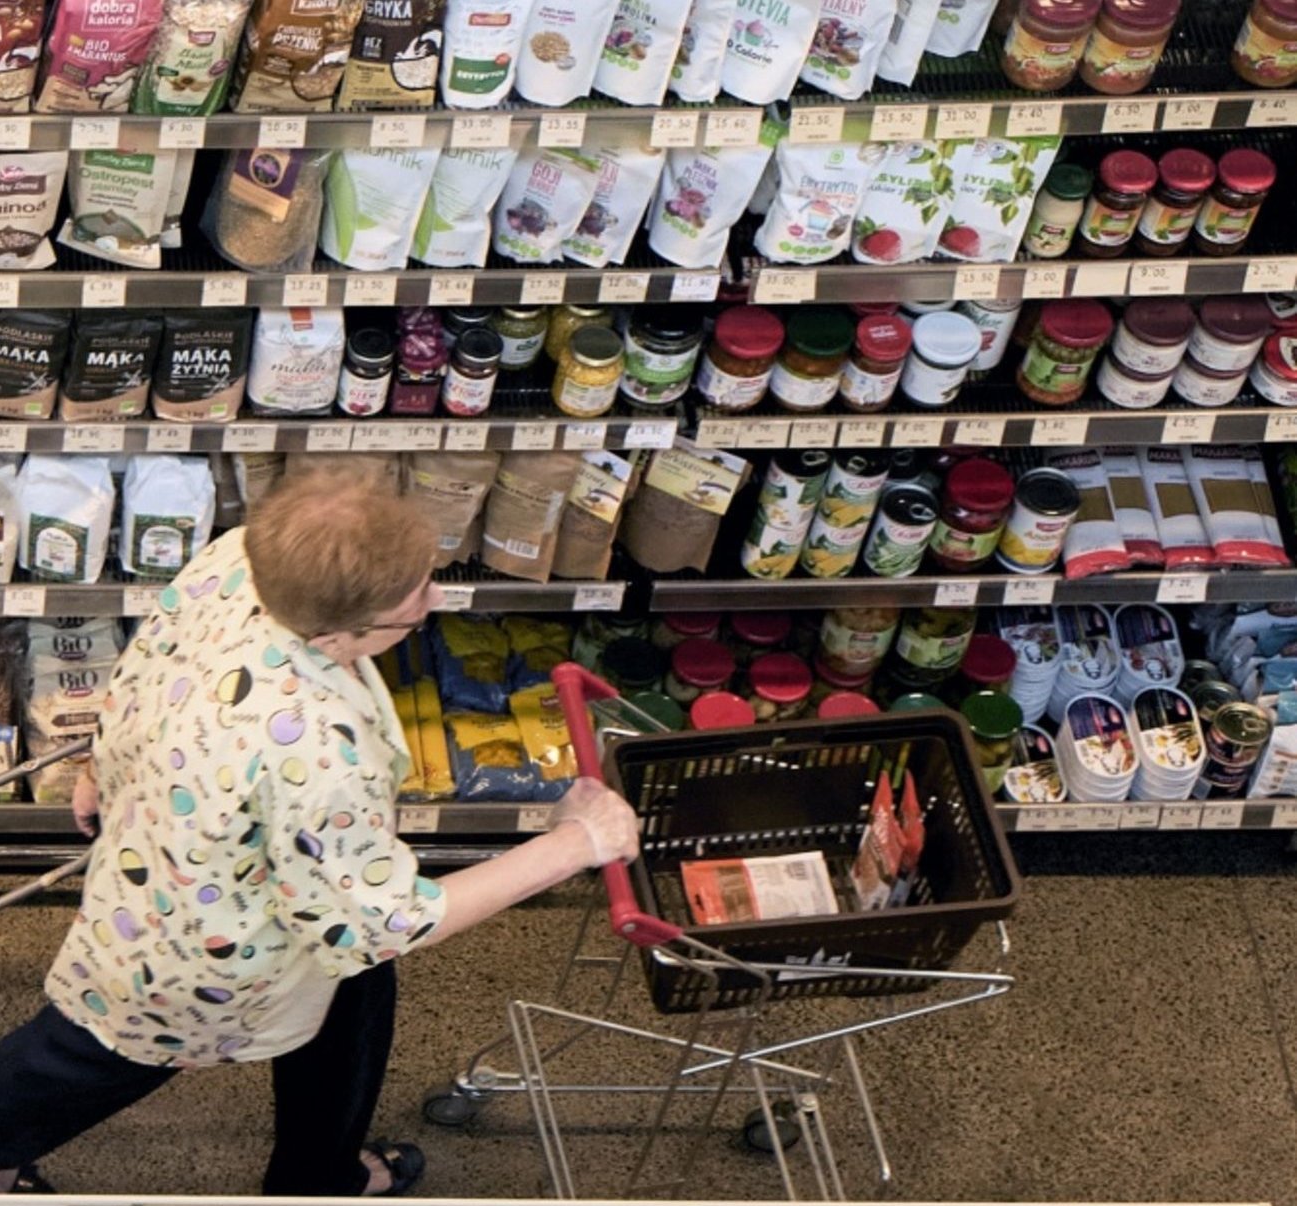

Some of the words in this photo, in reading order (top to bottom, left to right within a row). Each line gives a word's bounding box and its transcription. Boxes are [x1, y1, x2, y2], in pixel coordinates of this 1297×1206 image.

[89, 0, 136, 15] dobra
[87, 13, 134, 27] kaloria
[81, 168, 155, 191] Ostropest
